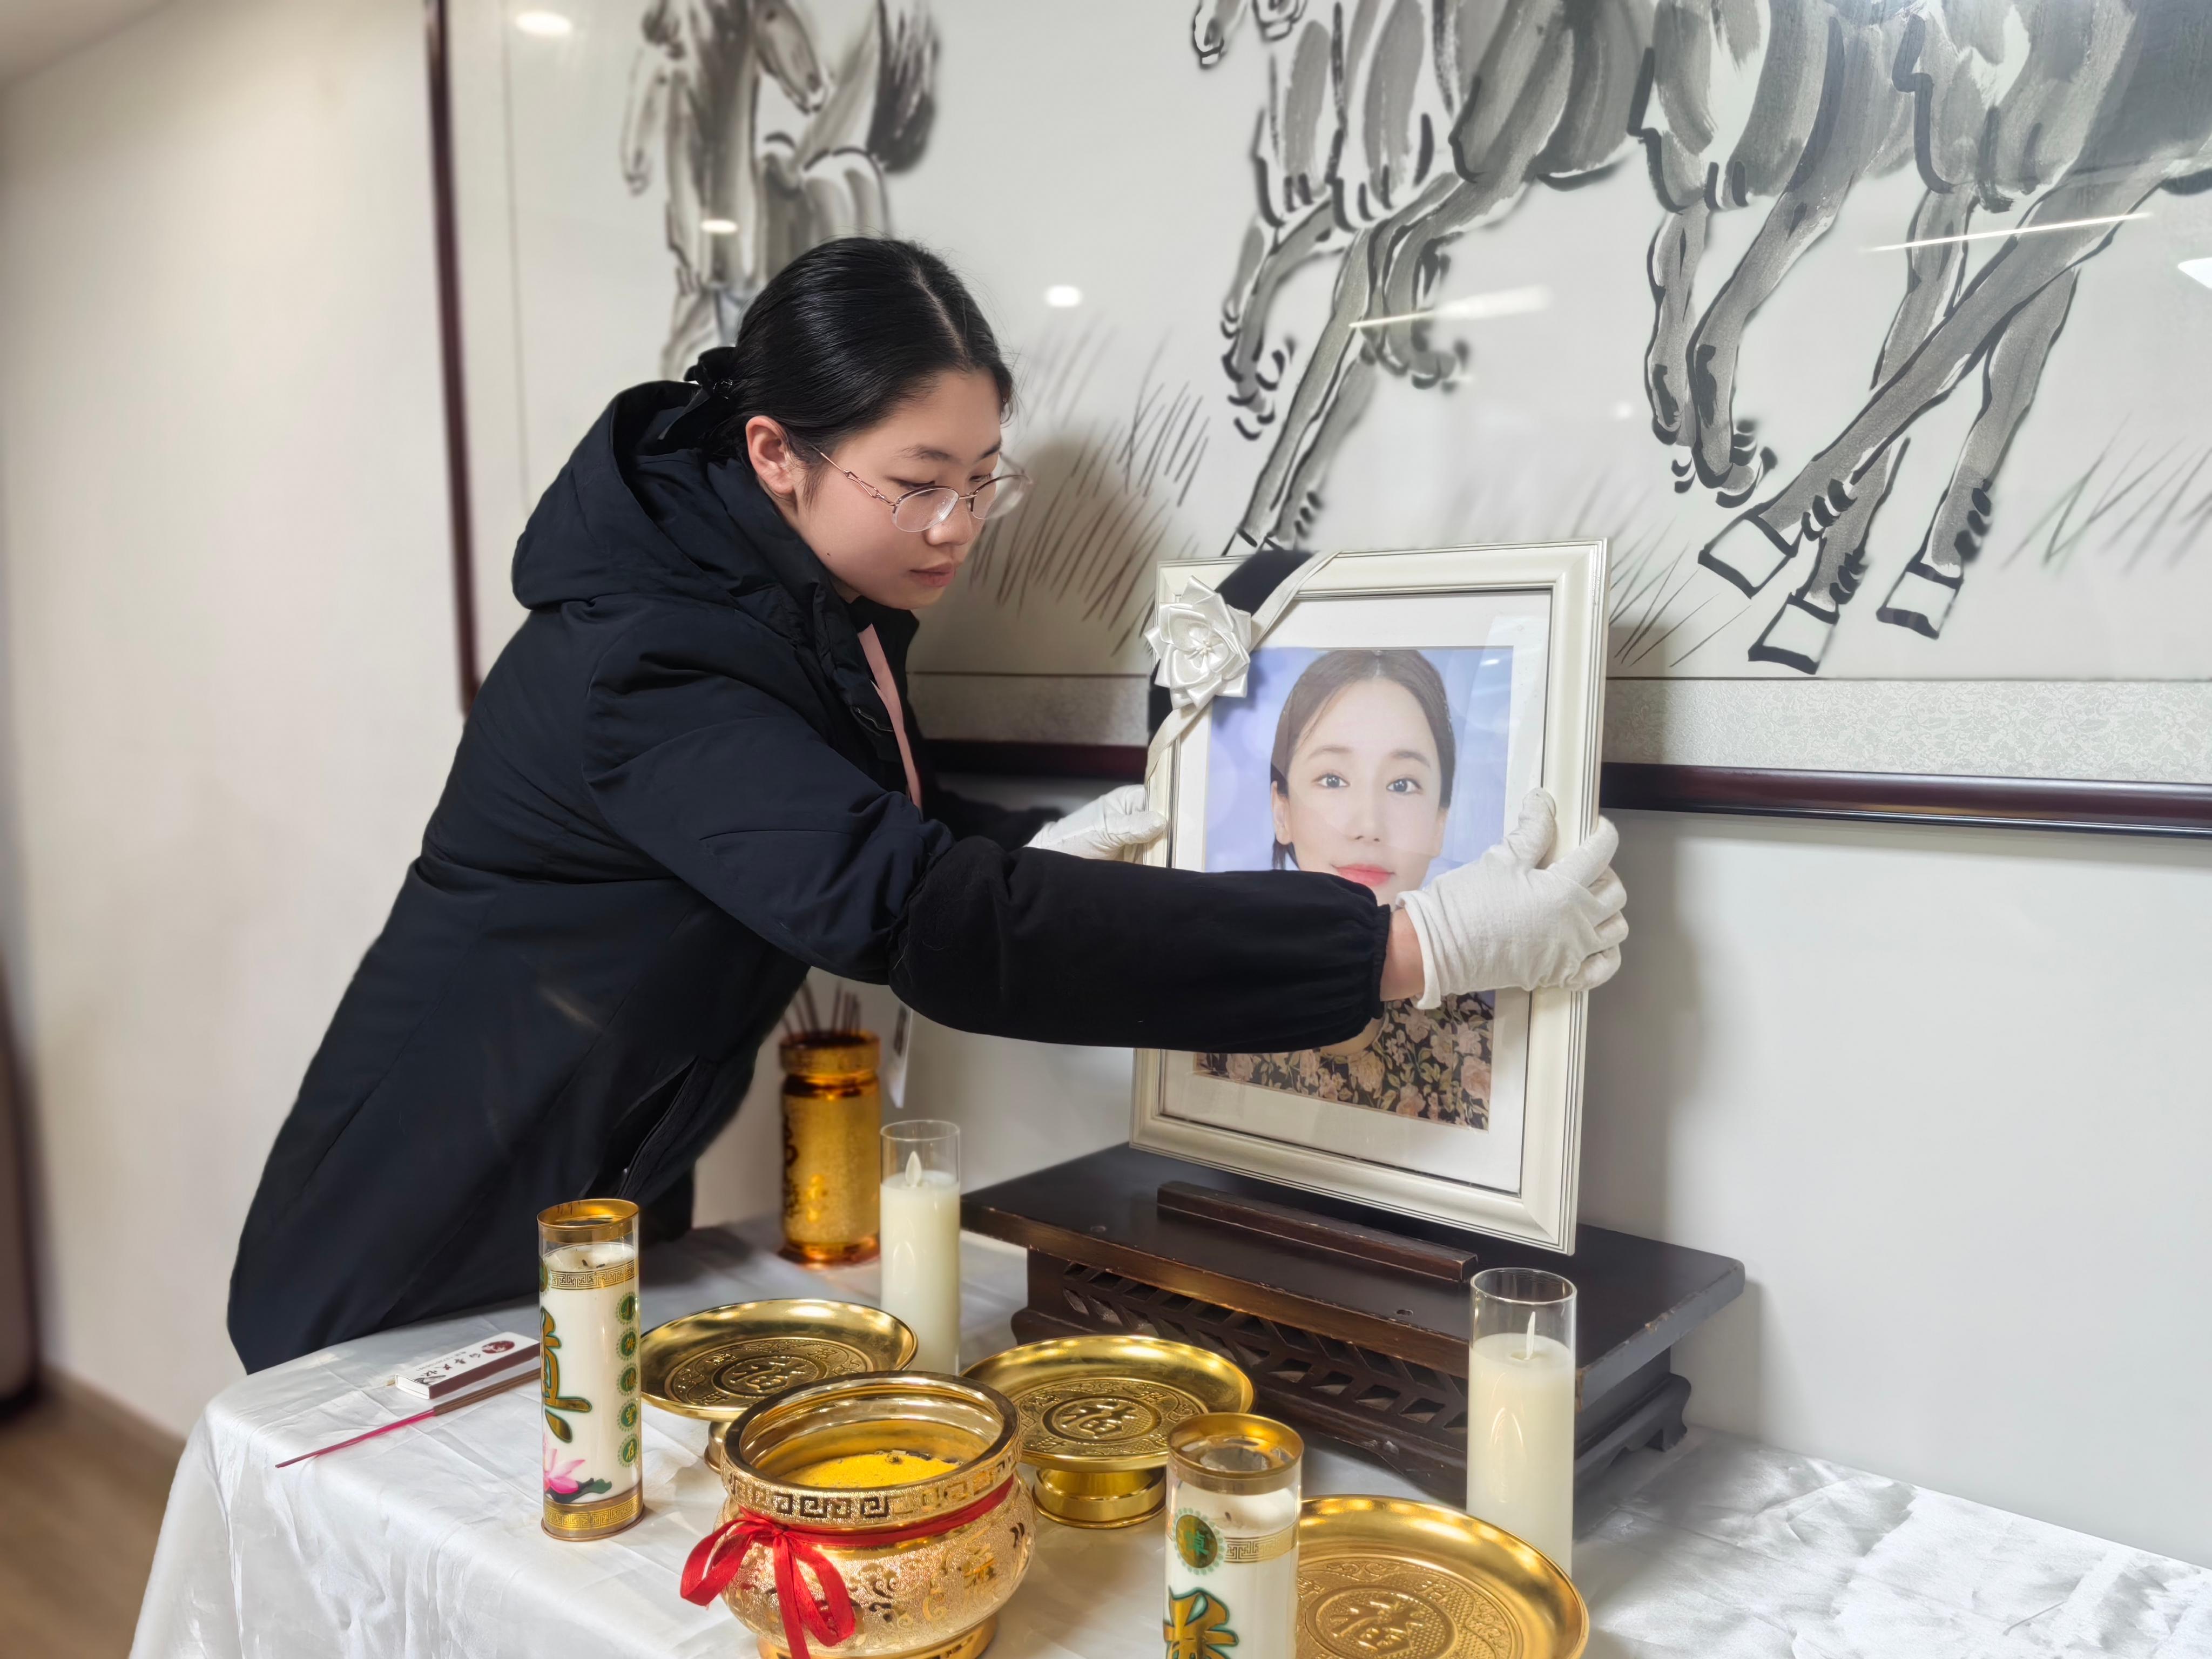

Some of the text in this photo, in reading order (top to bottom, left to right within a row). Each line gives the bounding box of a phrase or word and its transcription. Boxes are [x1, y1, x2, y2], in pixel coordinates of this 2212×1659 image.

[730, 1360, 806, 1393] 福
[1059, 1402, 1136, 1439] 福
[1330, 1597, 1425, 1656] 福
